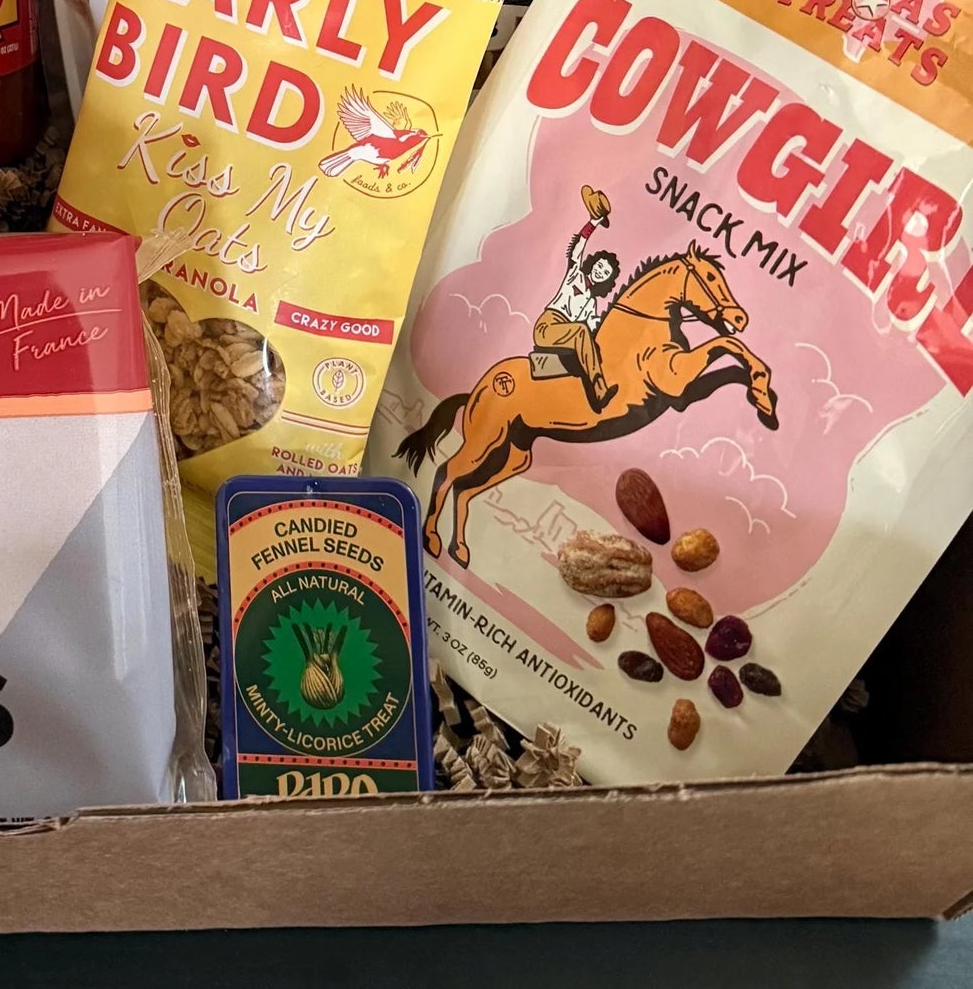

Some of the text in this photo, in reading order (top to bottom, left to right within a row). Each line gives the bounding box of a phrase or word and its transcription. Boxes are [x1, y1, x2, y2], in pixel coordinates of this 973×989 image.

[94, 1, 322, 146] BIRD
[116, 111, 337, 252] Kiss My
[385, 182, 393, 193] &
[54, 201, 80, 228] EXTRA
[645, 166, 744, 258] SNACK
[156, 191, 267, 274] Oats
[741, 230, 809, 287] MIX
[79, 286, 111, 304] in
[159, 260, 259, 313] RANOLA
[290, 311, 380, 337] CRAZY GOOD
[13, 325, 109, 371] France
[324, 359, 359, 375] PLANT
[320, 389, 352, 403] BASED
[271, 446, 358, 475] ROLLED OATS
[274, 517, 358, 539] CANDIED
[251, 537, 385, 572] FENNEL SEEDS
[270, 575, 365, 606] ALL NATURAL
[442, 632, 499, 680] 3 OZ (85g)
[515, 649, 638, 741] ANTIOXIDANTS
[246, 684, 400, 752] MINTY-LICORICE TREAT
